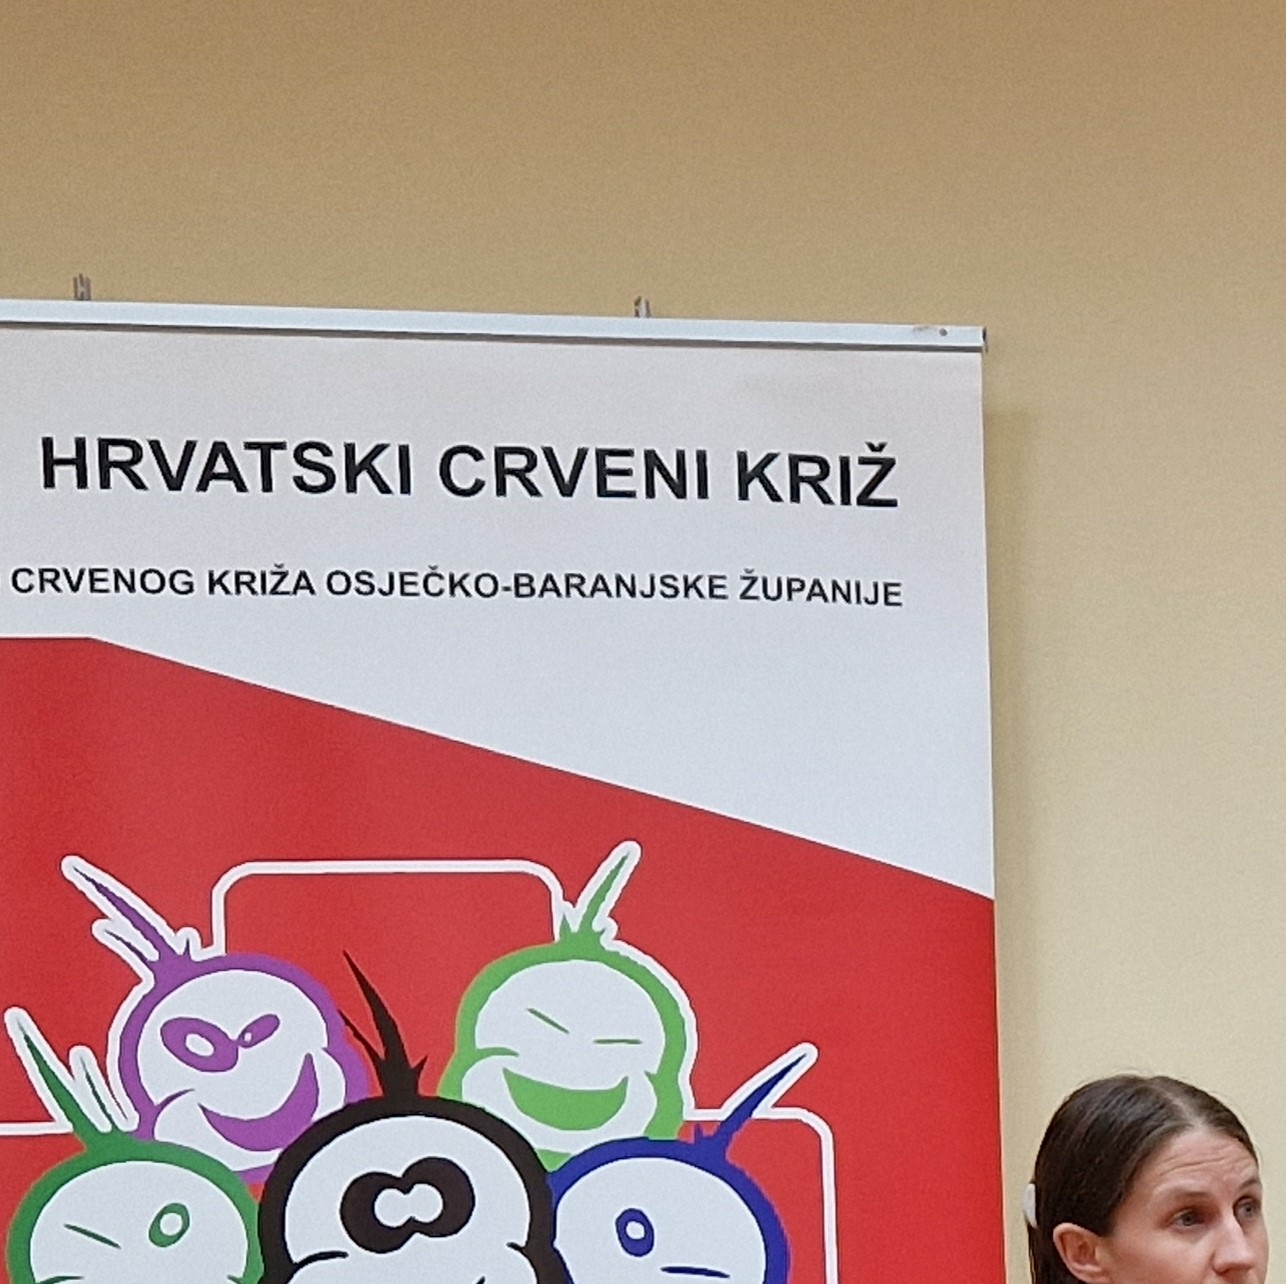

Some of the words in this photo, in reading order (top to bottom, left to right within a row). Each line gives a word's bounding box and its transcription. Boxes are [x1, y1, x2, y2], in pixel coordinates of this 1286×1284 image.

[41, 436, 411, 496] HRVATSKI
[439, 444, 709, 500] CRVENI
[736, 441, 898, 508] KRIŽ
[11, 567, 195, 596] CRVENOG
[208, 563, 316, 596] KRIŽA
[326, 565, 729, 600] OSJEČKO-BARANJSKE
[739, 568, 903, 607] ŽUPANIJE
